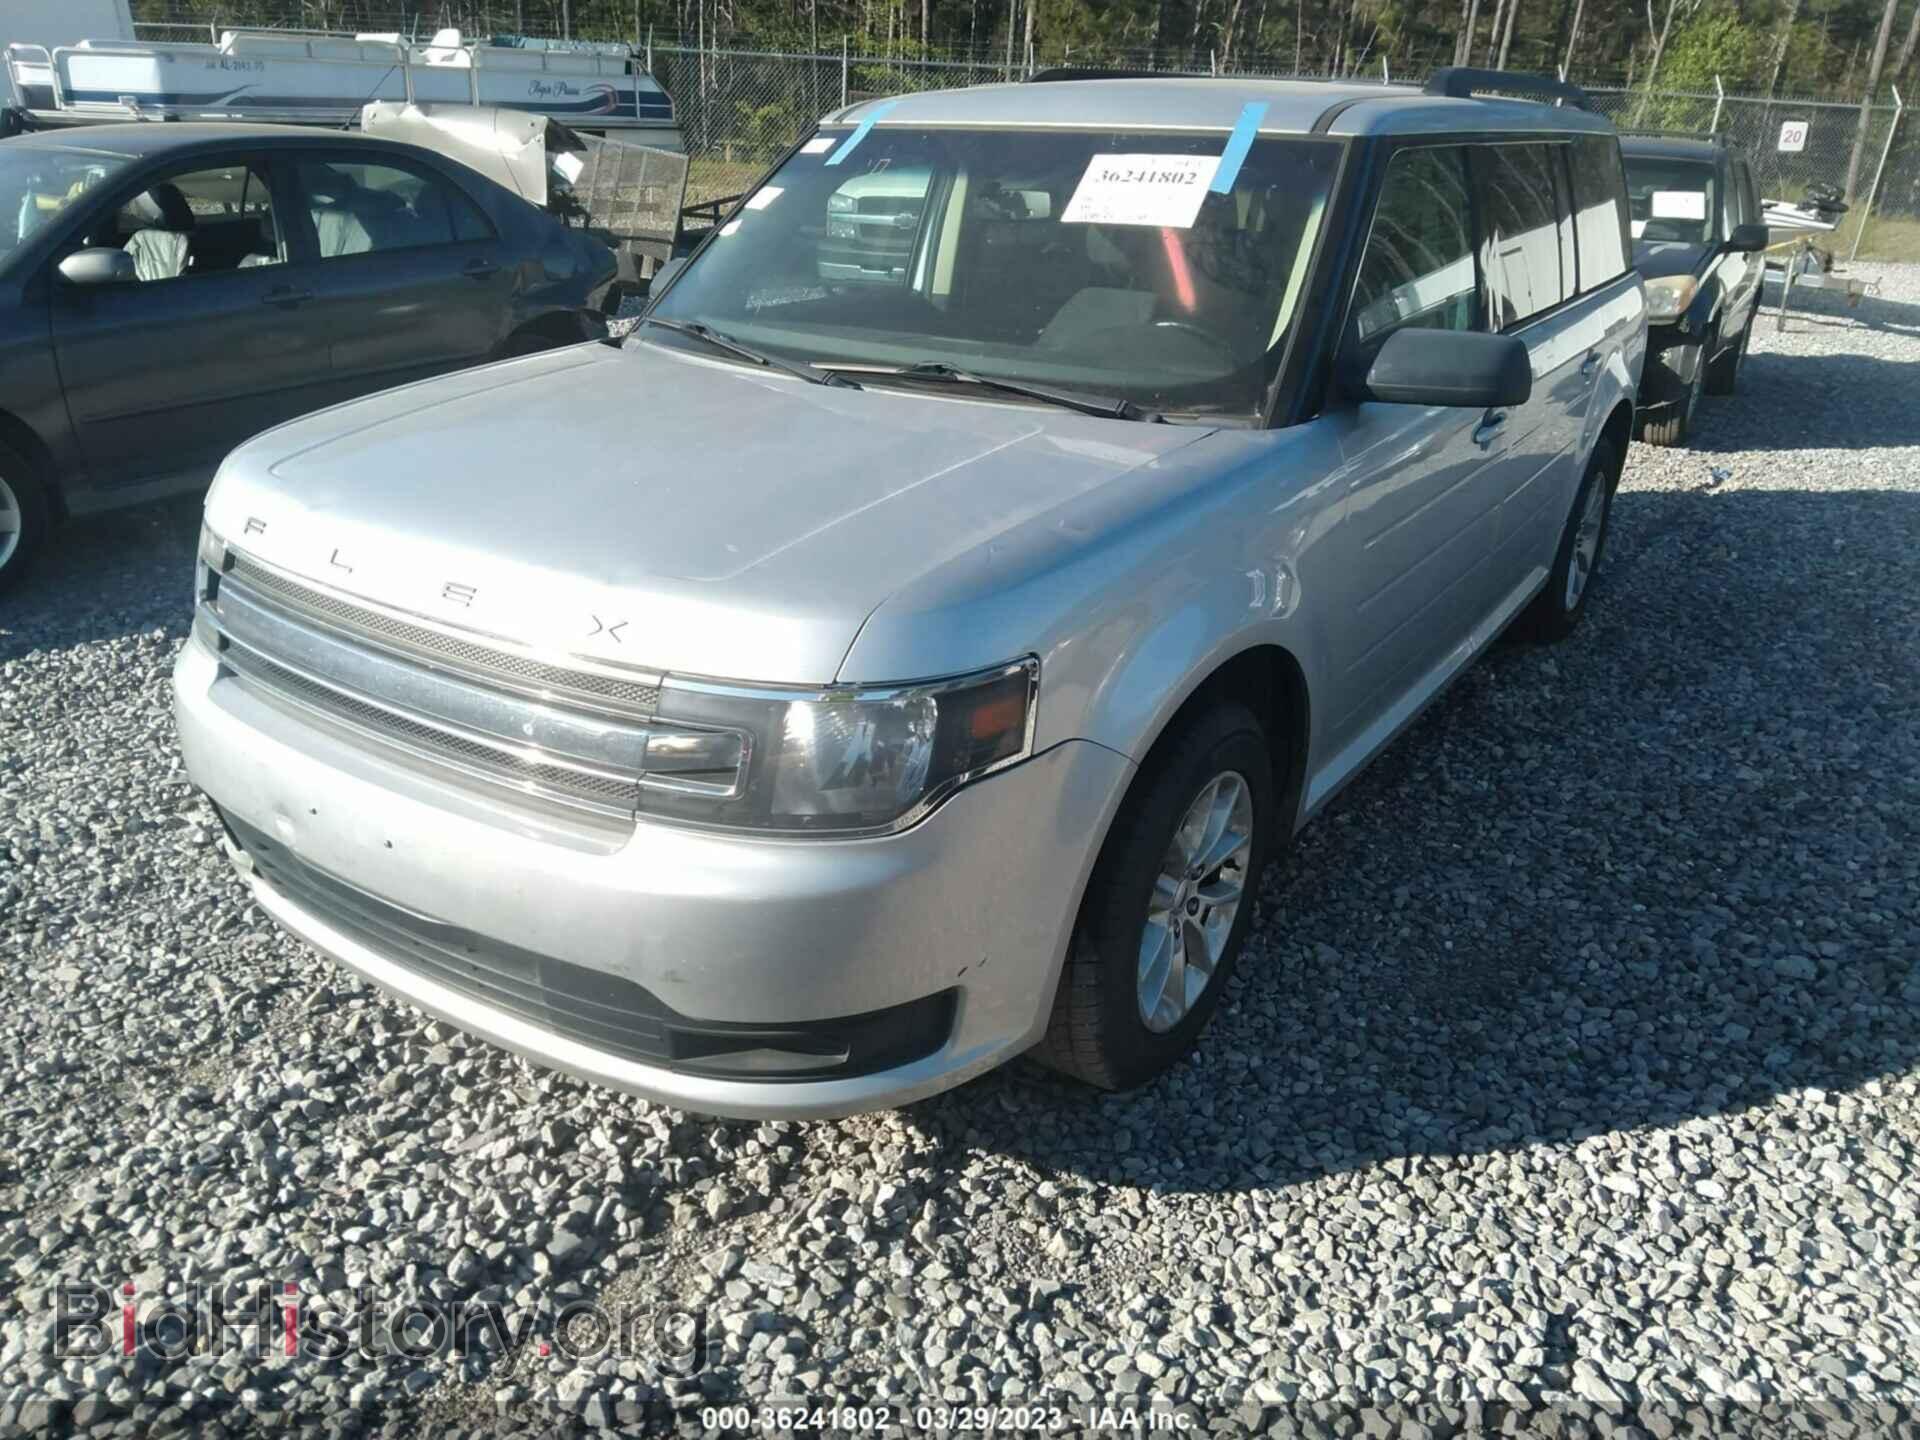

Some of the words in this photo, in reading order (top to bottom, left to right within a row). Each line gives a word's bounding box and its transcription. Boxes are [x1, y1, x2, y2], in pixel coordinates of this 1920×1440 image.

[1783, 129, 1802, 144] 20
[1101, 169, 1198, 186] 36241802
[243, 515, 630, 643] FLEX
